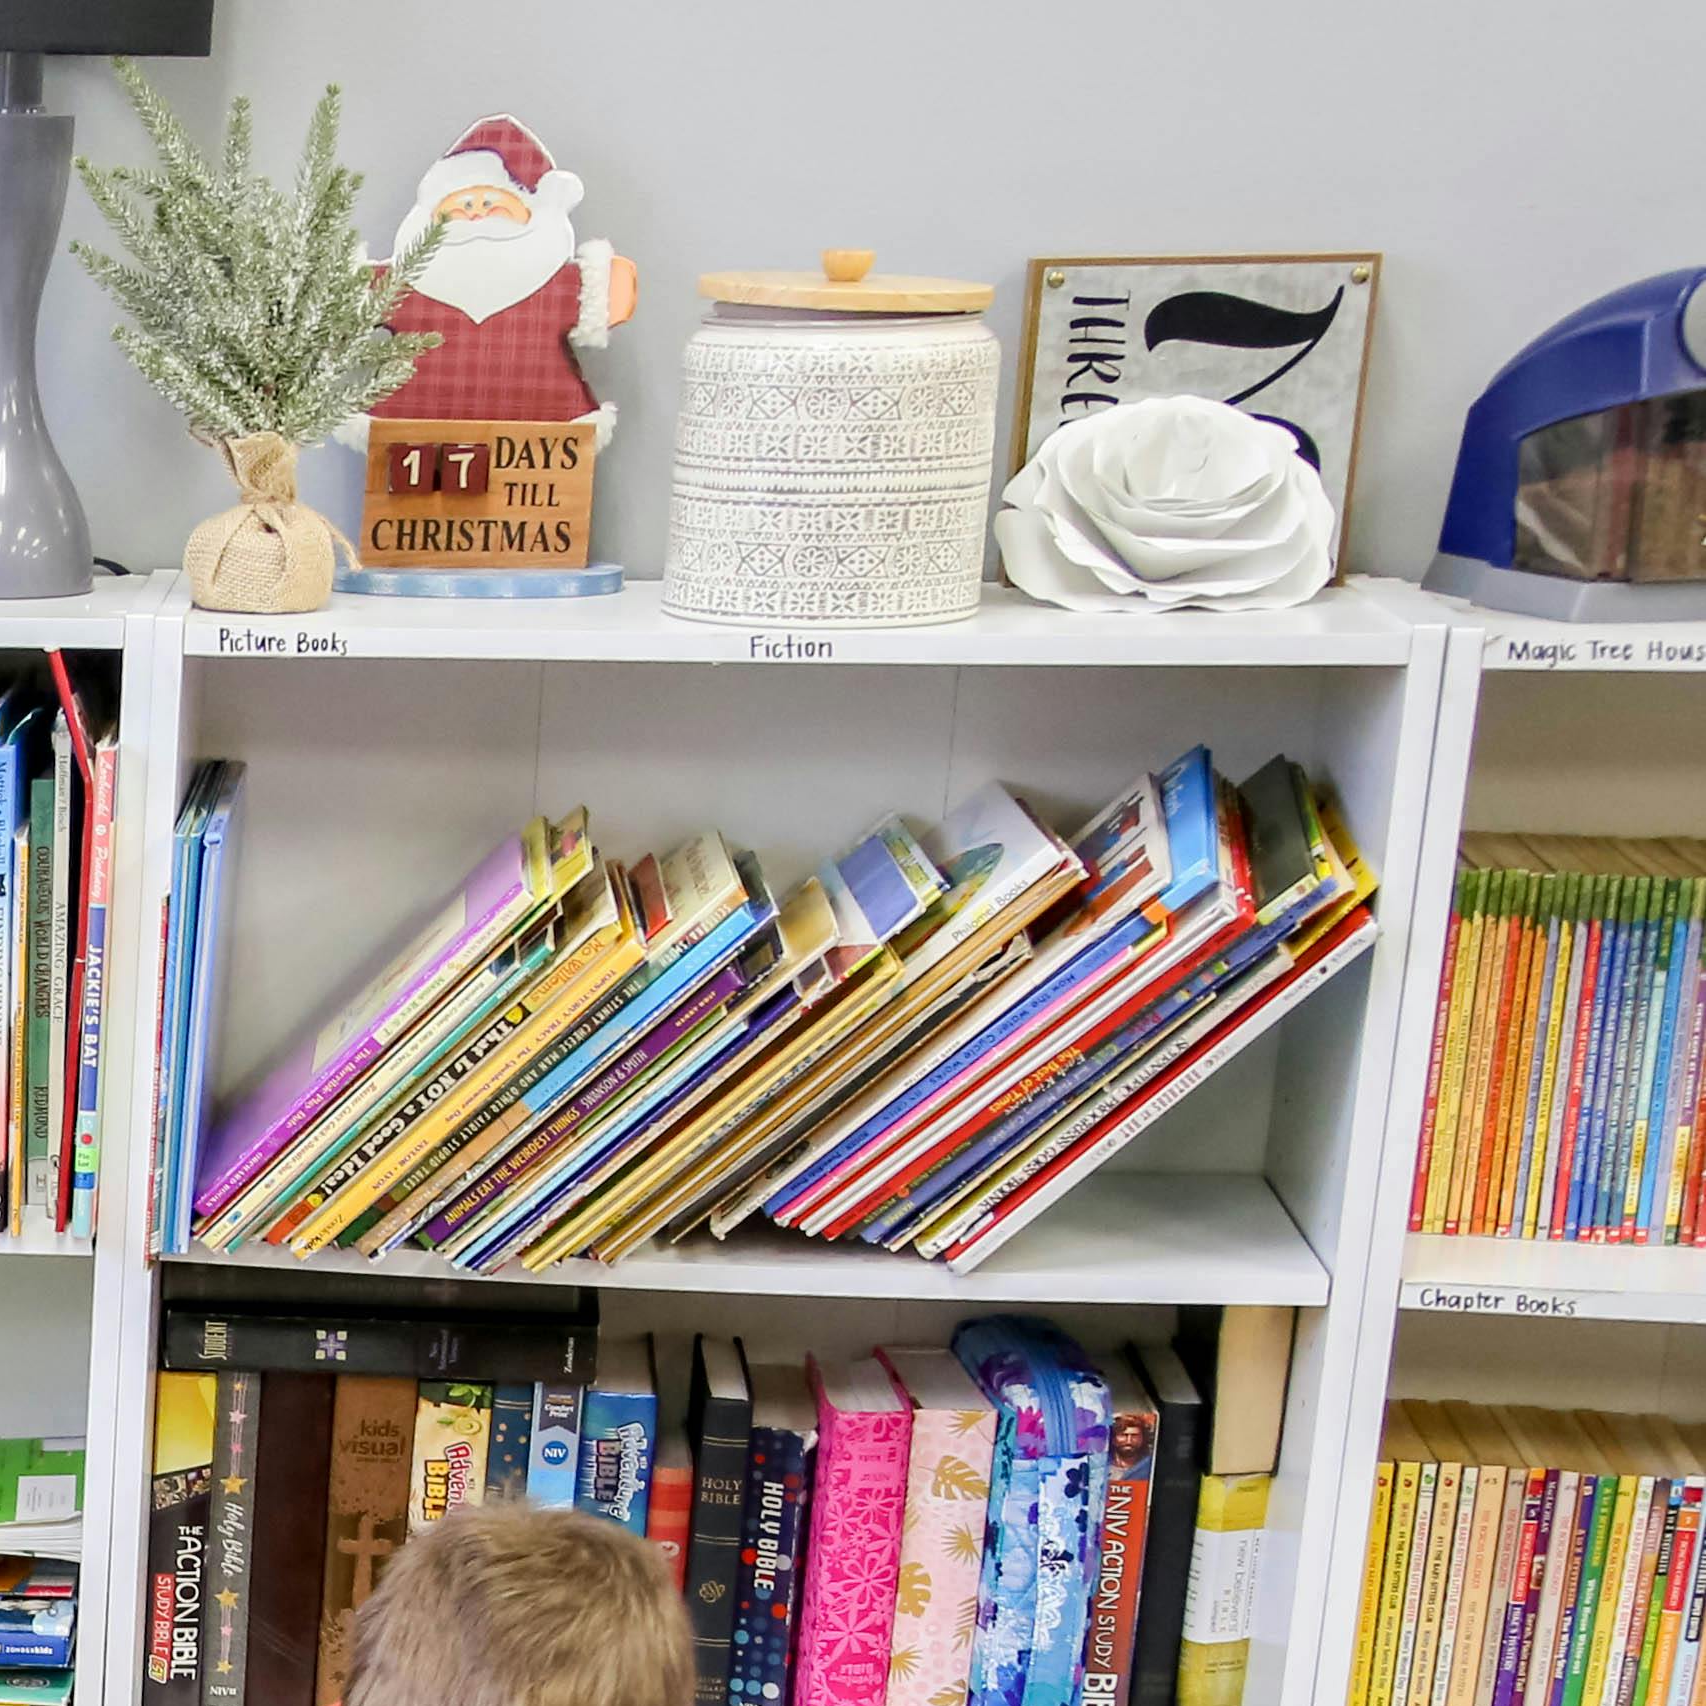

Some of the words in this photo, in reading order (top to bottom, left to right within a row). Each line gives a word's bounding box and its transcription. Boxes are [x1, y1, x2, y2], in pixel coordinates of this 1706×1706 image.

[494, 436, 579, 470] DAYS
[504, 483, 560, 507] TILL
[371, 519, 570, 553] CHRISTMAS
[219, 628, 286, 652] Picture
[294, 630, 351, 658] Books
[750, 634, 832, 659] Fiction
[1508, 641, 1572, 665] Magic
[1592, 640, 1632, 661] Tree
[35, 845, 52, 915] COURAGEOUS
[949, 901, 1000, 946] Philomel
[991, 874, 1032, 911] Books
[33, 919, 51, 960] WORLD
[53, 901, 66, 971] AMAZING
[34, 962, 51, 1019] CHANGERS
[52, 976, 66, 1024] GRACE
[85, 944, 104, 1027] JACKIE'S
[82, 1034, 99, 1068] BAT
[465, 1016, 516, 1064] That
[33, 1085, 49, 1139] REDMOND
[403, 1104, 419, 1120] a
[413, 1072, 455, 1111] NOT
[362, 1114, 409, 1158] Good
[442, 1190, 483, 1226] ANIMALS
[475, 1178, 497, 1198] EAT
[490, 1164, 513, 1185] THE
[505, 1132, 551, 1172] WEIRDEST
[543, 1104, 583, 1140] THINGS
[578, 1073, 620, 1111] SWANSON
[620, 1048, 649, 1075] SMITH
[319, 1148, 371, 1197] Idea!
[1419, 1288, 1504, 1314] Chapter
[1515, 1294, 1575, 1318] Books
[543, 1447, 567, 1459] NIV
[700, 1492, 742, 1505] BIBLE
[702, 1477, 744, 1493] HOLY
[1109, 1484, 1133, 1494] THE
[216, 1501, 244, 1538] Holy
[759, 1480, 784, 1534] HOLY
[1104, 1495, 1132, 1536] NIV
[178, 1525, 204, 1536] THE
[220, 1538, 244, 1578] Bible
[754, 1536, 780, 1592] BIBLE
[1095, 1539, 1127, 1612] ACTION
[157, 1576, 171, 1617] STUDY
[176, 1536, 202, 1624] ACTION
[151, 1618, 168, 1657] BIBLE
[169, 1626, 199, 1681] BIBLE
[1089, 1614, 1116, 1669] STUDY
